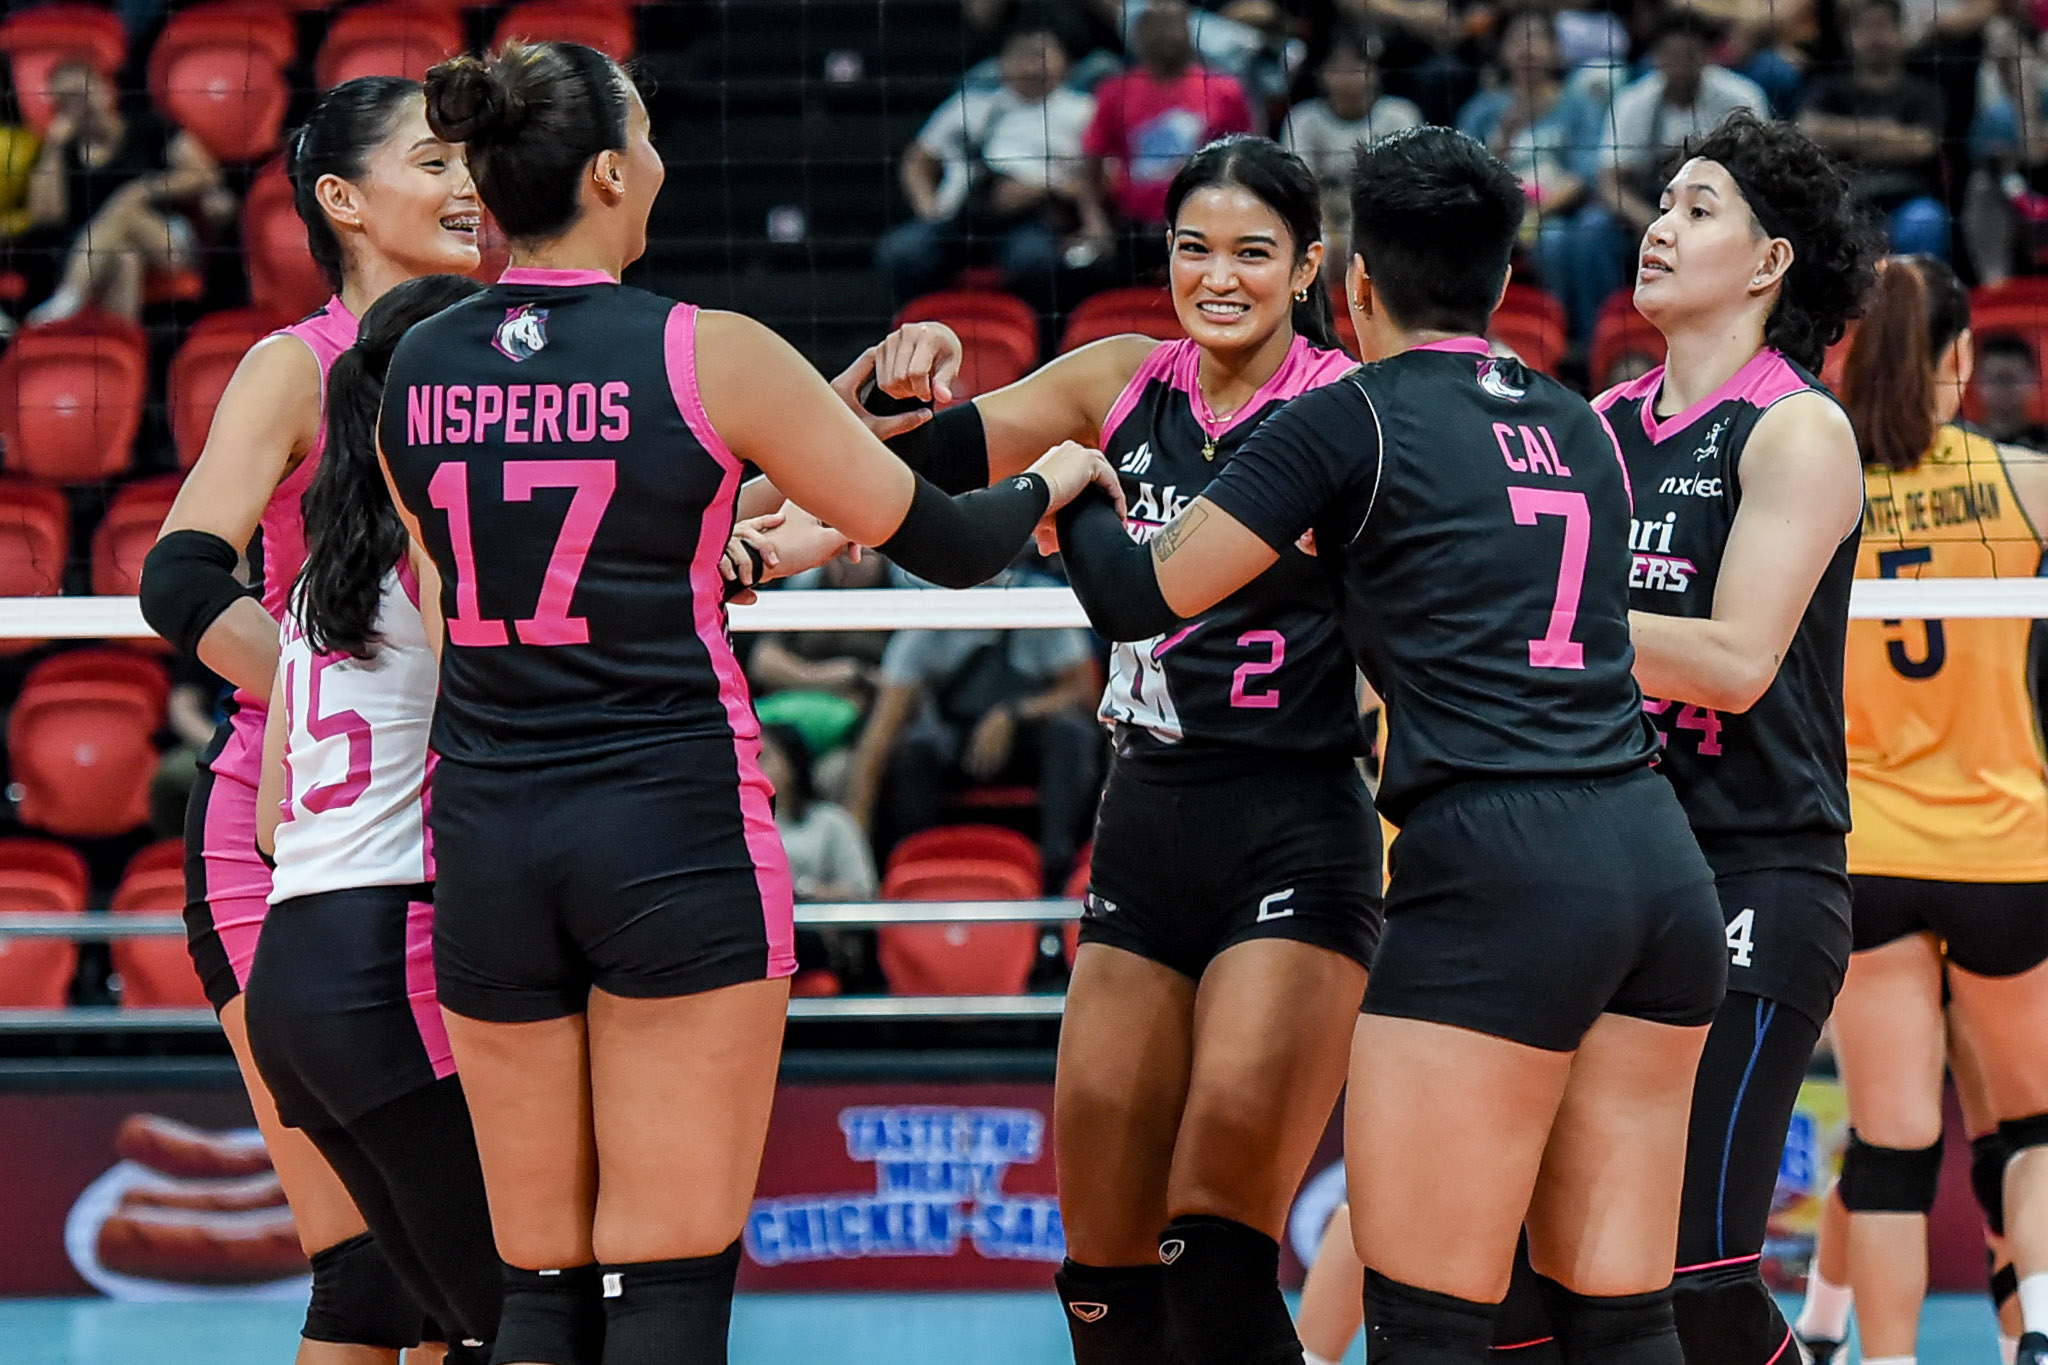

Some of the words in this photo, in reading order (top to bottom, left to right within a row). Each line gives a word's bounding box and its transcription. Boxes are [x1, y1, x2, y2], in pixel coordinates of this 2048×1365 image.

[407, 380, 630, 446] NISPEROS
[1492, 422, 1572, 477] CAL
[1931, 481, 2000, 527] GUZMAN
[427, 459, 617, 646] 17
[1506, 486, 1591, 670] 7
[1878, 546, 1946, 680] 5
[1230, 629, 1287, 709] 2
[1724, 907, 1755, 968] 4
